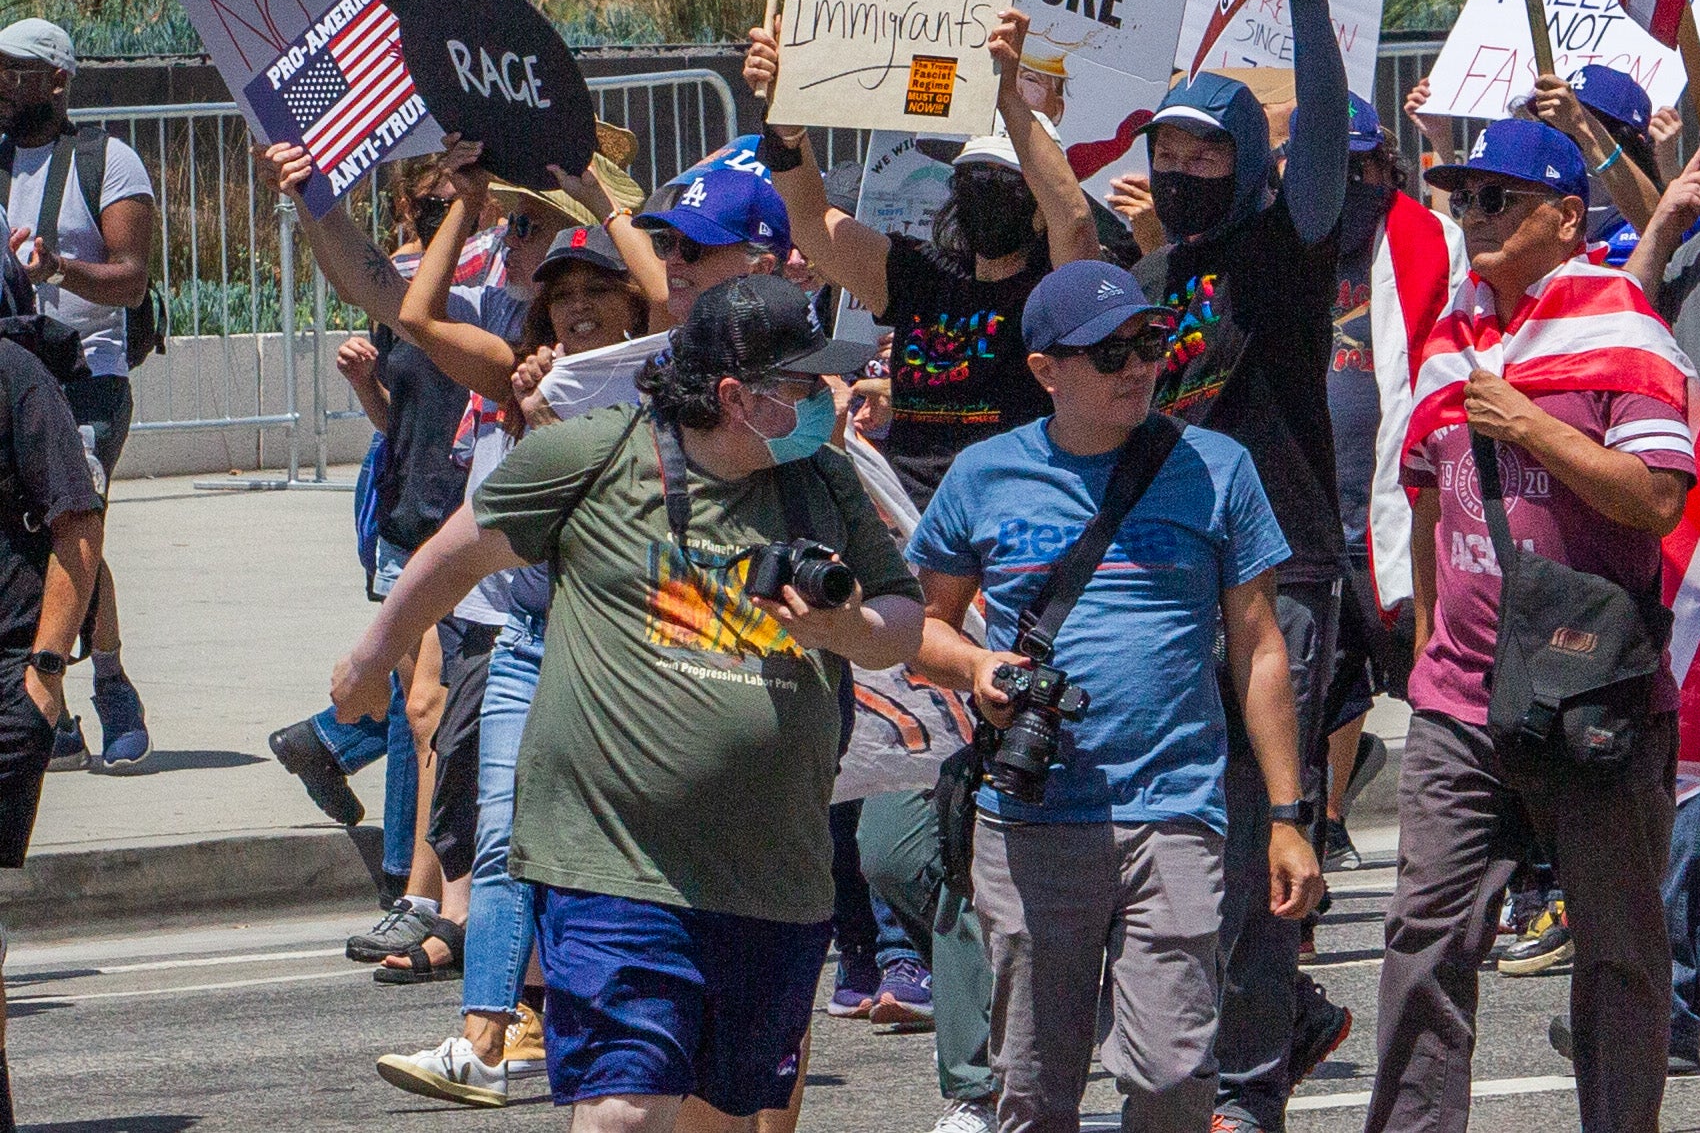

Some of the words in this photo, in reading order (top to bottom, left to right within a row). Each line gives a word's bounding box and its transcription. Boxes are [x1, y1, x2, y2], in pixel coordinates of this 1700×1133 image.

[1236, 18, 1293, 62] SINCE
[1548, 10, 1626, 53] NOT
[447, 40, 551, 109] RAGE
[912, 79, 950, 91] Regime
[914, 69, 951, 80] Fascist
[907, 92, 935, 102] MUST
[936, 93, 950, 104] GO
[327, 93, 427, 196] ANTI-TRU
[1525, 471, 1549, 495] 20
[681, 662, 743, 685] Progressive
[744, 672, 774, 687] Labor
[775, 677, 798, 693] Party
